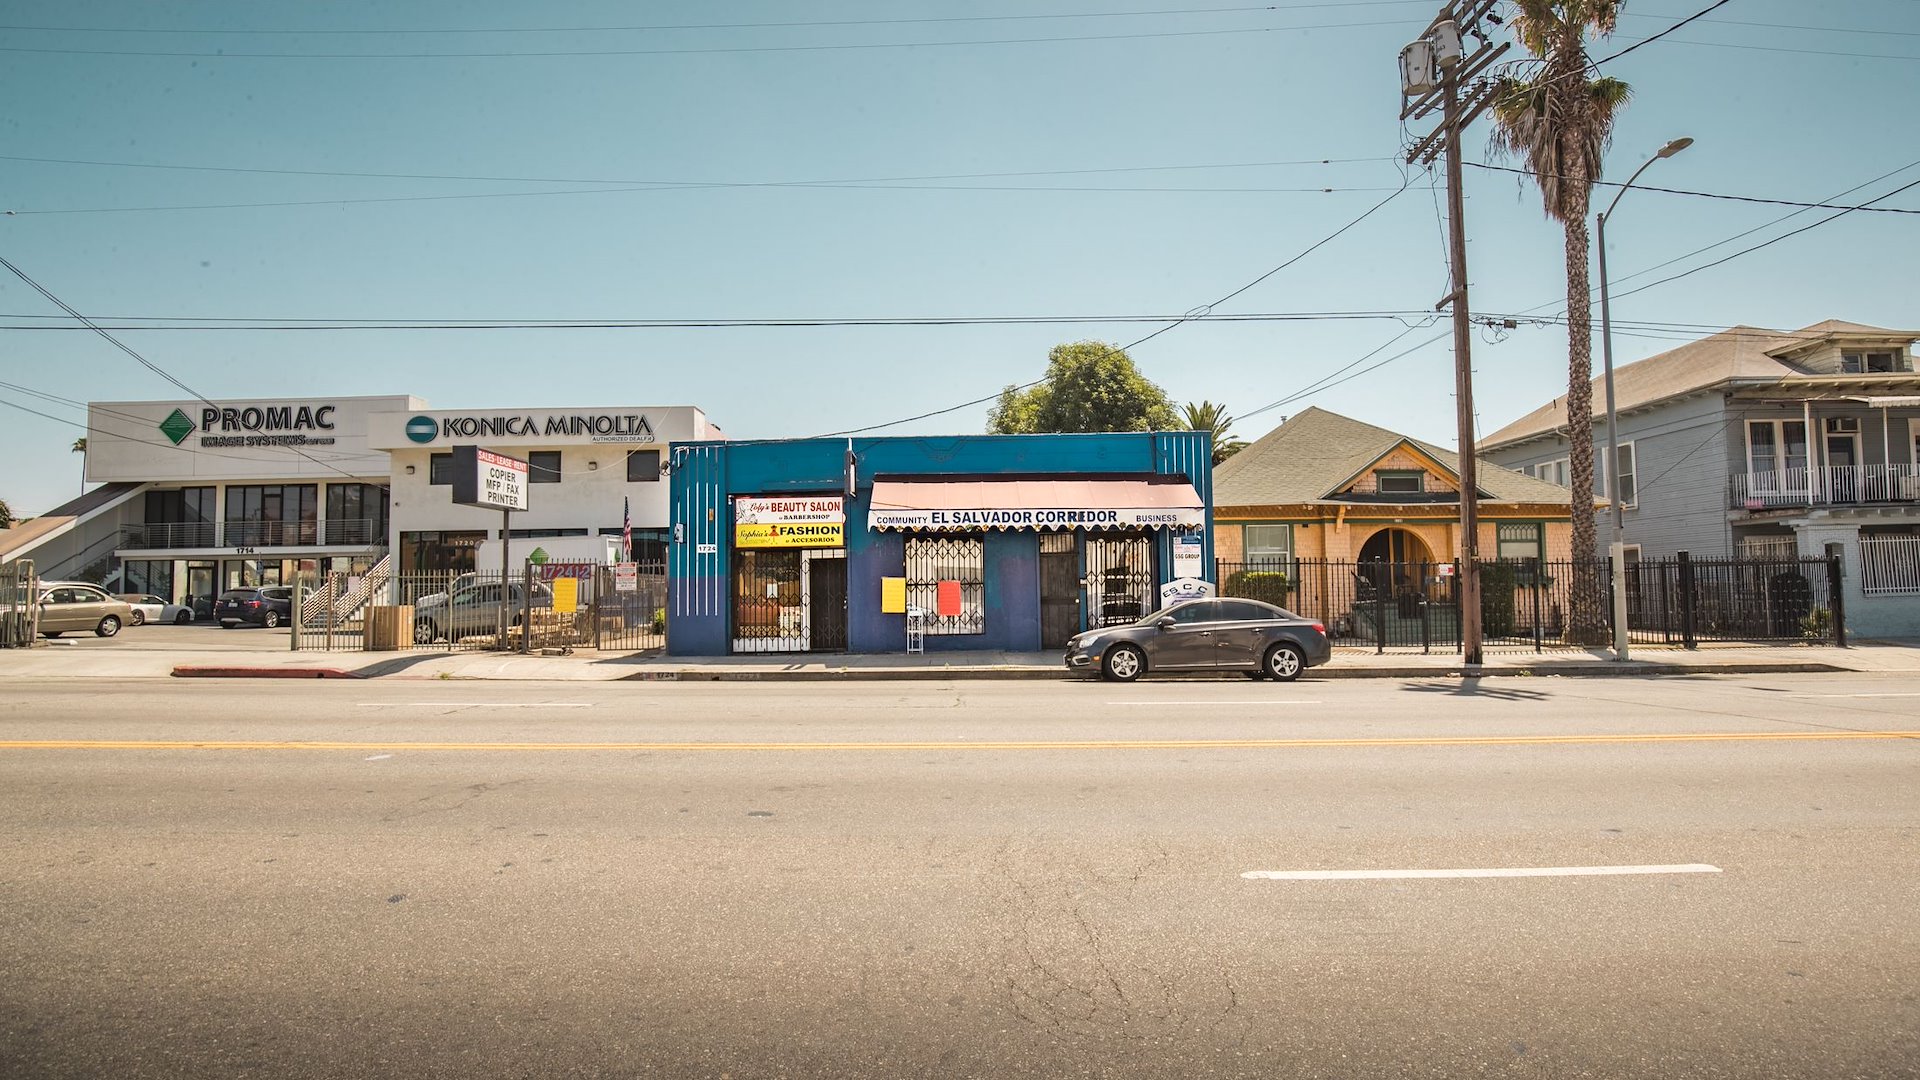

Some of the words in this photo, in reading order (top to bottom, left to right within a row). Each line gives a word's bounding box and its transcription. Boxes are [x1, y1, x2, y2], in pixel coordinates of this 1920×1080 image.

[201, 406, 335, 431] PROMAC
[443, 416, 539, 437] KONICA
[545, 414, 653, 436] MINOLTA
[246, 435, 305, 447] SYSTEMS
[479, 450, 495, 463] SALES
[497, 456, 512, 467] LEASE
[490, 467, 516, 482] COPIER
[486, 479, 501, 491] MFP
[506, 483, 520, 495] FAX
[488, 492, 519, 506] PRINTER
[771, 502, 807, 512] BEAUTY
[810, 501, 841, 512] SALON
[877, 516, 928, 524] COMMUNITY
[932, 511, 949, 523] EL
[952, 511, 1032, 523] SALVADOR
[1035, 510, 1118, 523] CORREDOR
[1136, 514, 1178, 522] BUSINESS
[780, 526, 841, 536] FASHION
